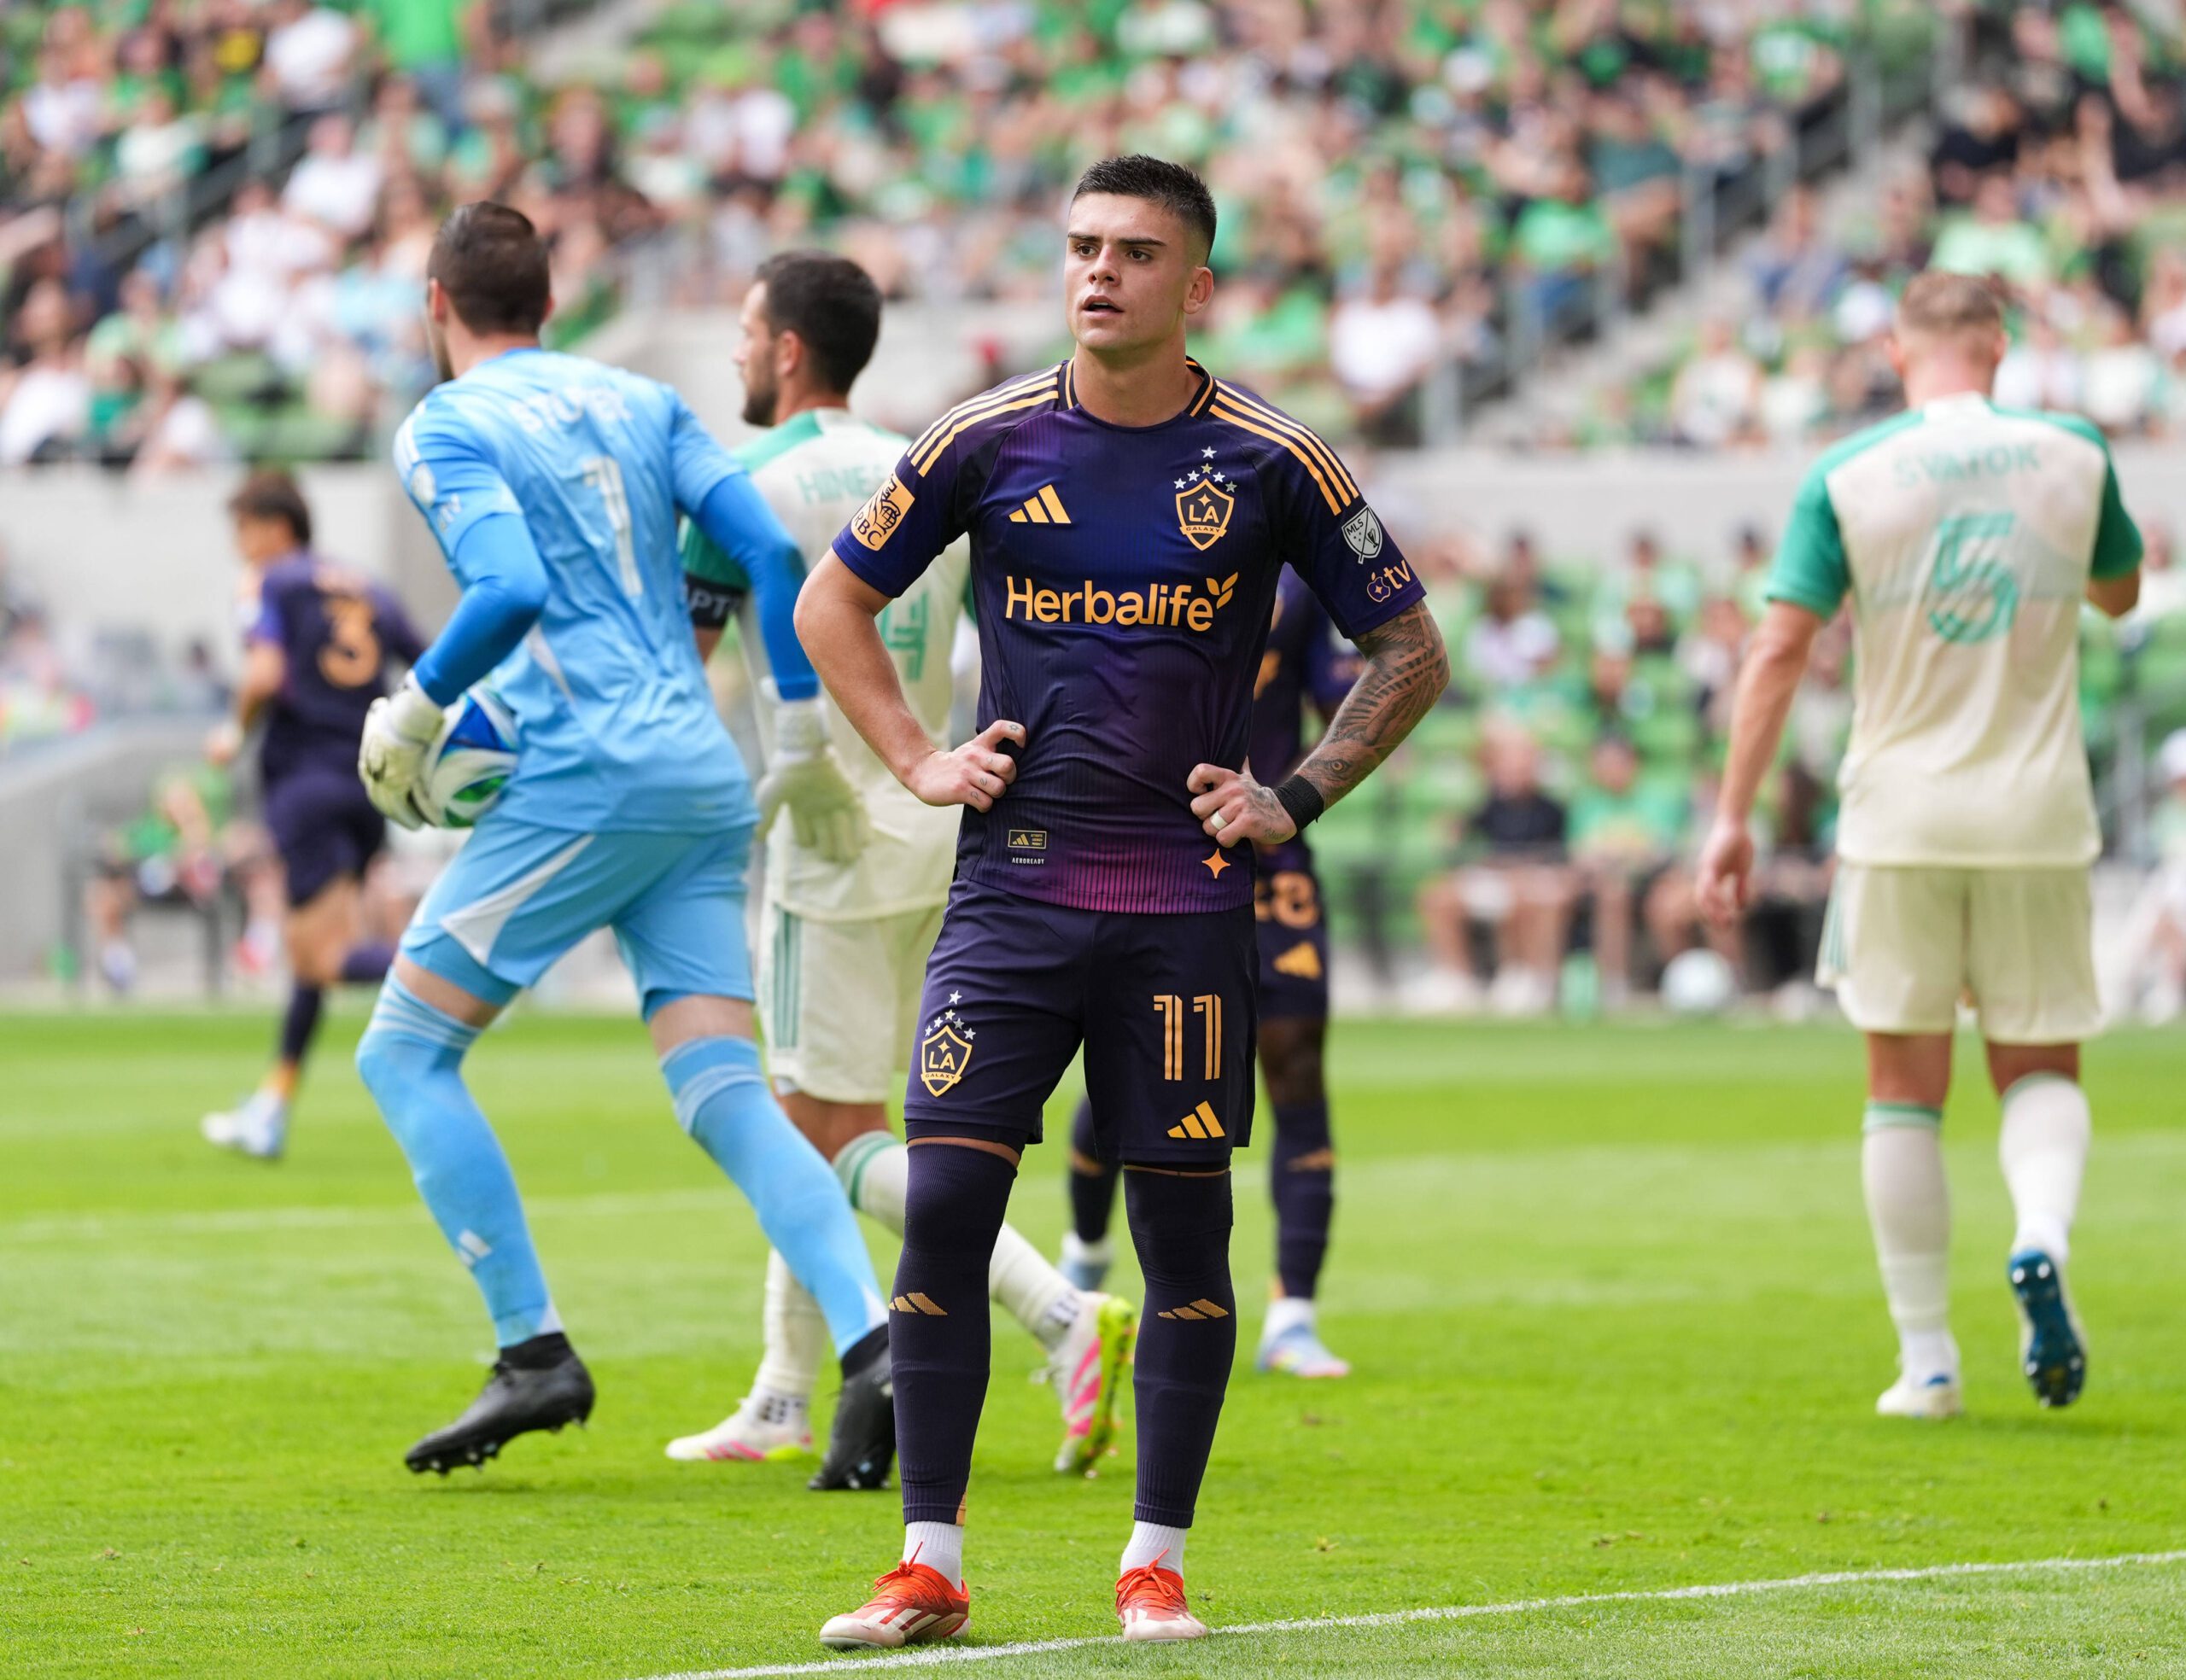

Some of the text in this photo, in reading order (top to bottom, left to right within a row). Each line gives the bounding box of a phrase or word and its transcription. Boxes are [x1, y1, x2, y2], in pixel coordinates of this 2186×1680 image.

[854, 511, 882, 546] RBC
[1189, 504, 1219, 523] LA
[1346, 518, 1364, 535] MLS
[1929, 511, 2018, 643] 5
[1006, 575, 1213, 632] Herbalife
[317, 595, 383, 688] 3
[928, 1051, 956, 1070] LA
[1153, 994, 1222, 1081] 11
